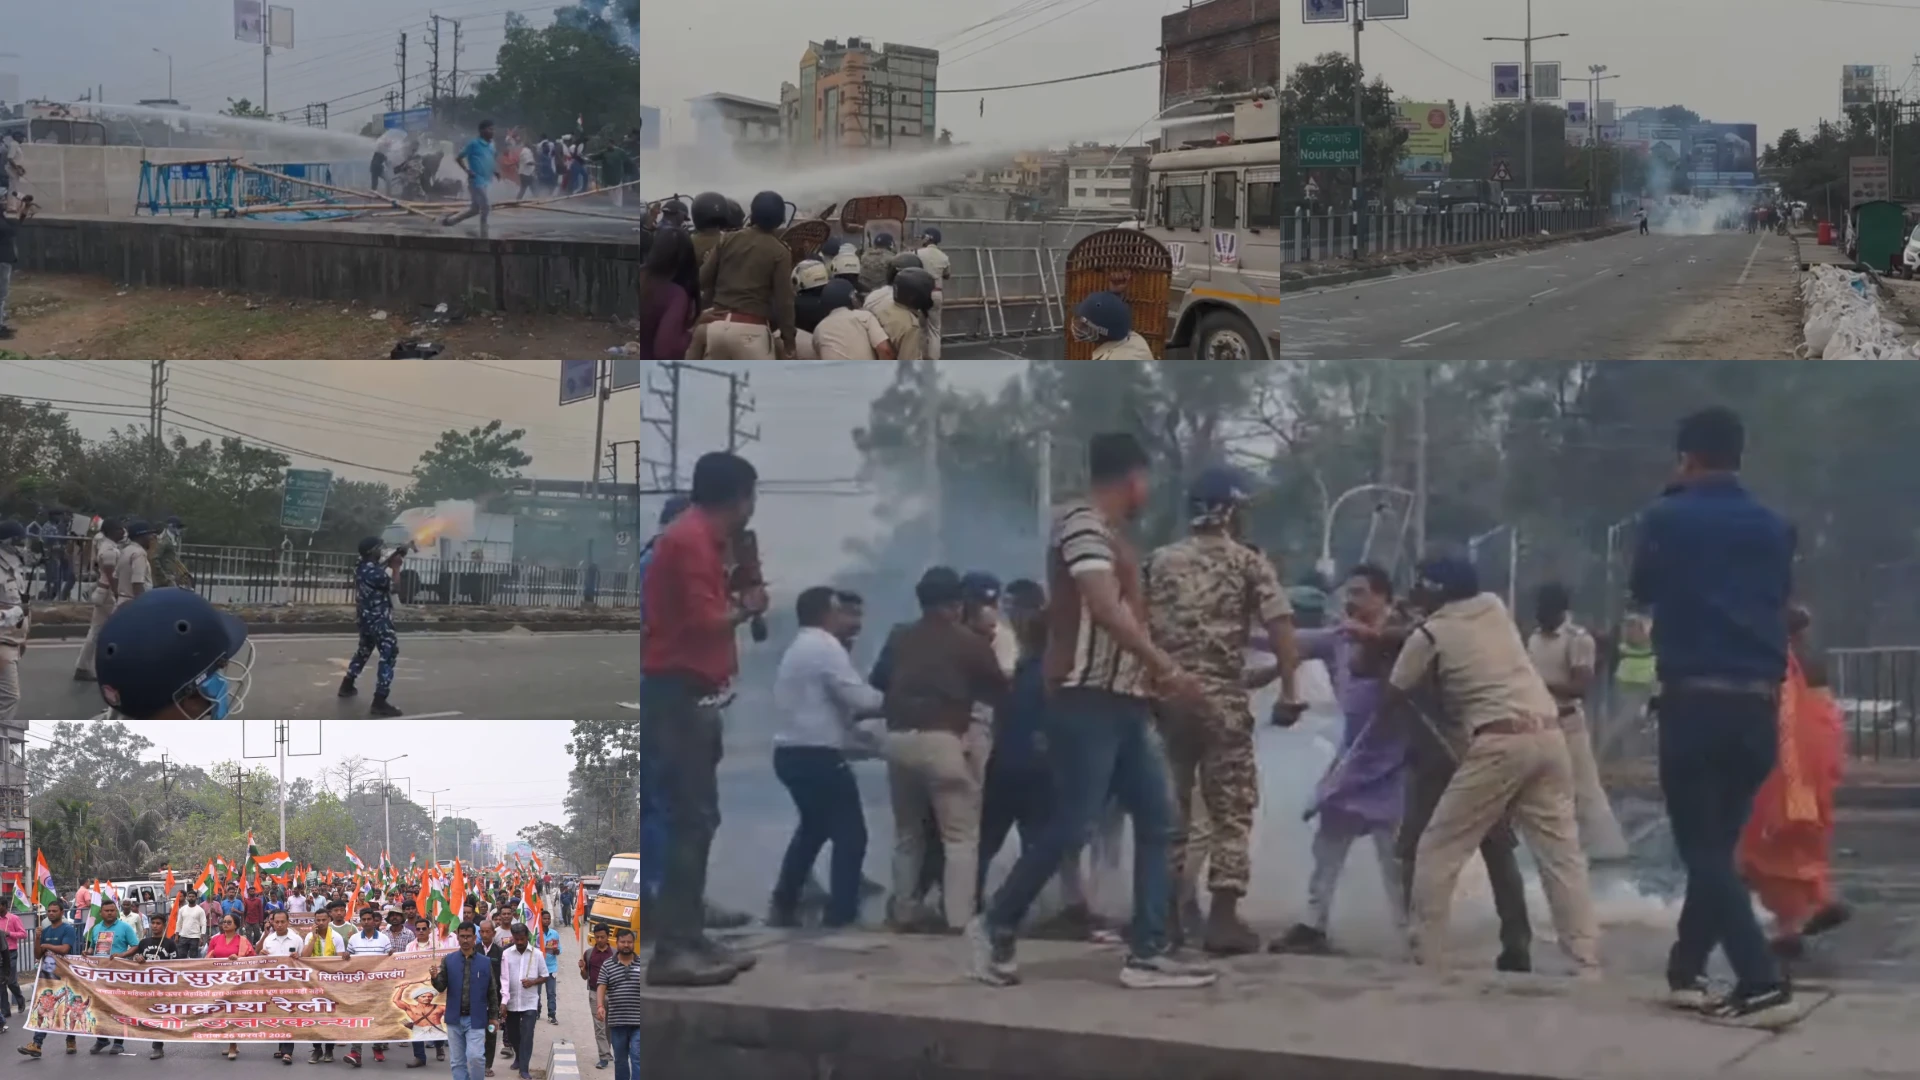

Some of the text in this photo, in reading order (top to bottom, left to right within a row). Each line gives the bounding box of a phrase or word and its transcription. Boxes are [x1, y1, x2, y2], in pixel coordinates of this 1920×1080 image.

[1306, 132, 1352, 145] নৌকাঘাট
[1300, 148, 1359, 162] Noukaghat
[69, 964, 179, 984] जनजाति
[182, 967, 258, 988] सुरक्षा
[263, 964, 312, 982] मंच
[318, 970, 365, 983] सिलीगुड़ी
[148, 996, 337, 1015] आक्रोश रैली
[193, 1032, 221, 1040] दिनांक
[237, 1031, 266, 1039] फरवरी
